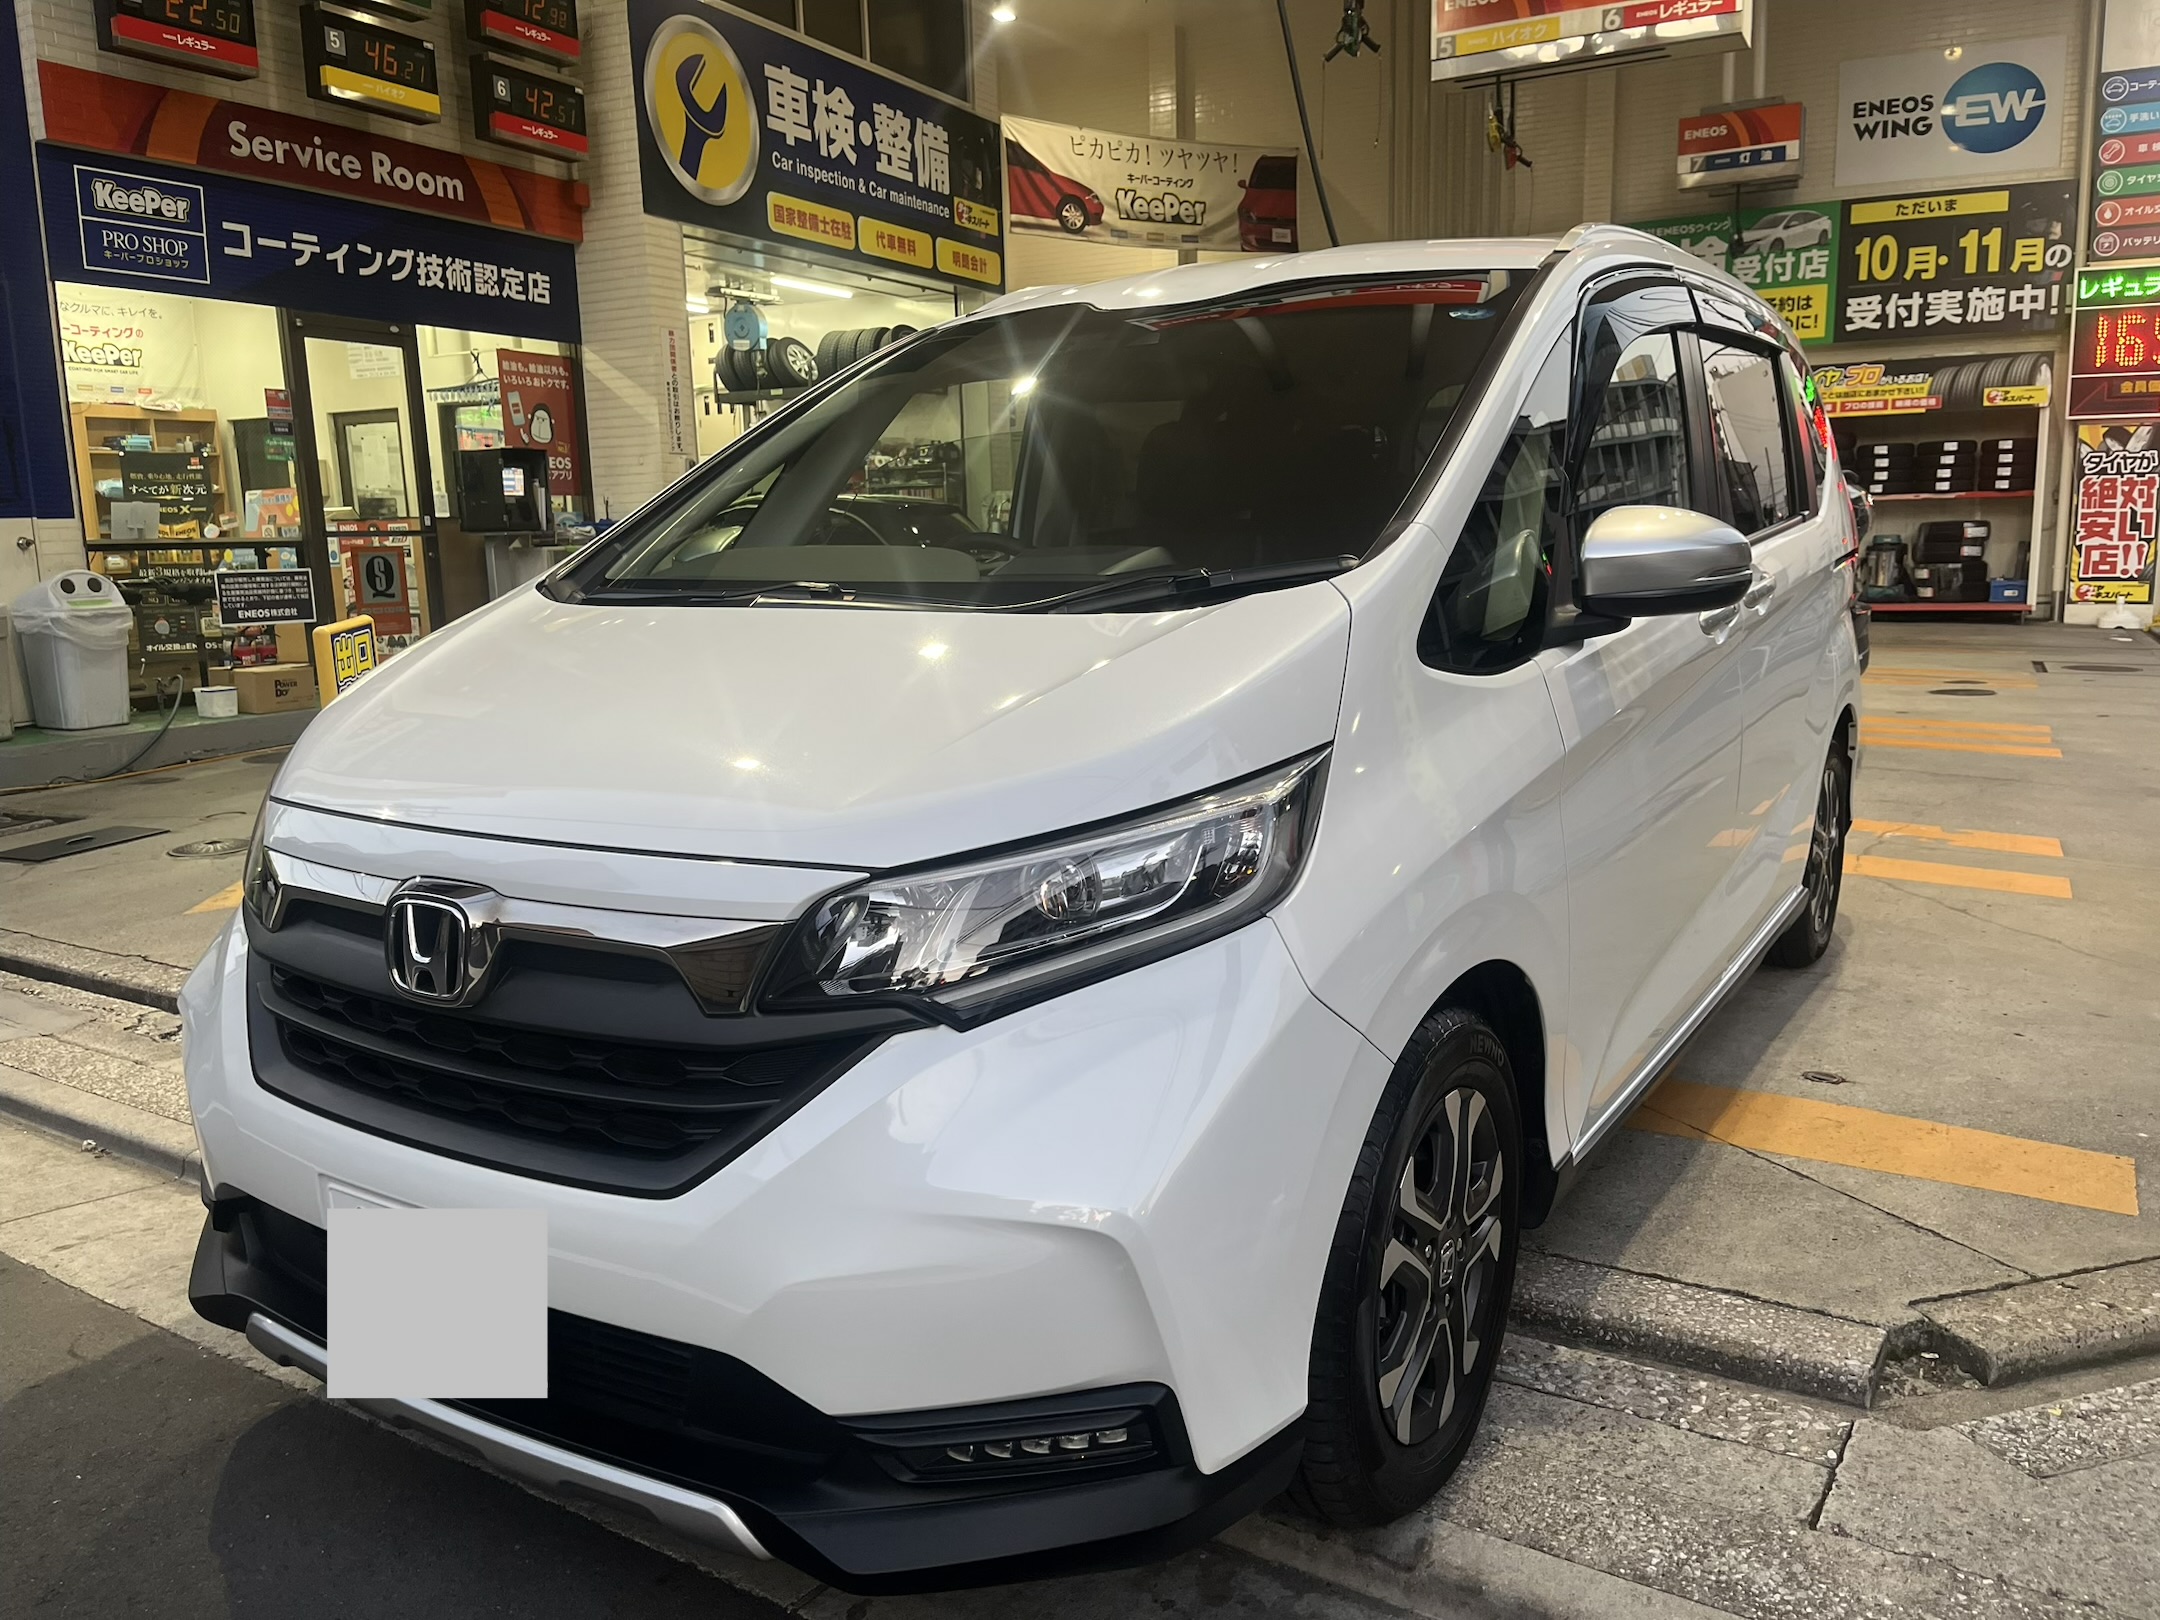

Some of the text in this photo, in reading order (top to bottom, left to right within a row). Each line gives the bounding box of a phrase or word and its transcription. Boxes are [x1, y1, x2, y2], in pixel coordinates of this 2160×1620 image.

[1444, 0, 1499, 12] ENE
[1604, 9, 1622, 30] 6
[330, 31, 340, 48] 5
[1492, 23, 1548, 46] ハイオク
[1440, 37, 1453, 58] 5
[497, 80, 507, 97] 6
[1853, 94, 1934, 119] ENEOS
[1954, 88, 2038, 127] EW
[1684, 125, 1728, 140] ENEOS
[1853, 116, 1933, 142] WING
[228, 120, 465, 202] Service Room
[1692, 157, 1704, 172] 7
[772, 151, 951, 220] Car inspection & Car maintenance
[1127, 173, 1194, 189] キーパーコーティング
[92, 178, 191, 223] KeePer
[1115, 188, 1206, 226] KeePer
[1896, 198, 1959, 218] ただいま
[102, 229, 189, 258] PRO SHOP
[104, 250, 189, 270] キーパープロショップ
[222, 221, 552, 306] コーティング技術認定店
[62, 339, 142, 368] KeePer
[2083, 451, 2158, 474] タイヤが
[549, 470, 573, 480] アプリ
[129, 484, 207, 495] すべてが新次元
[2080, 475, 2157, 510] 絶対
[340, 524, 358, 532] ENEOS
[2079, 510, 2155, 543] 安い
[335, 631, 375, 684] 出口
